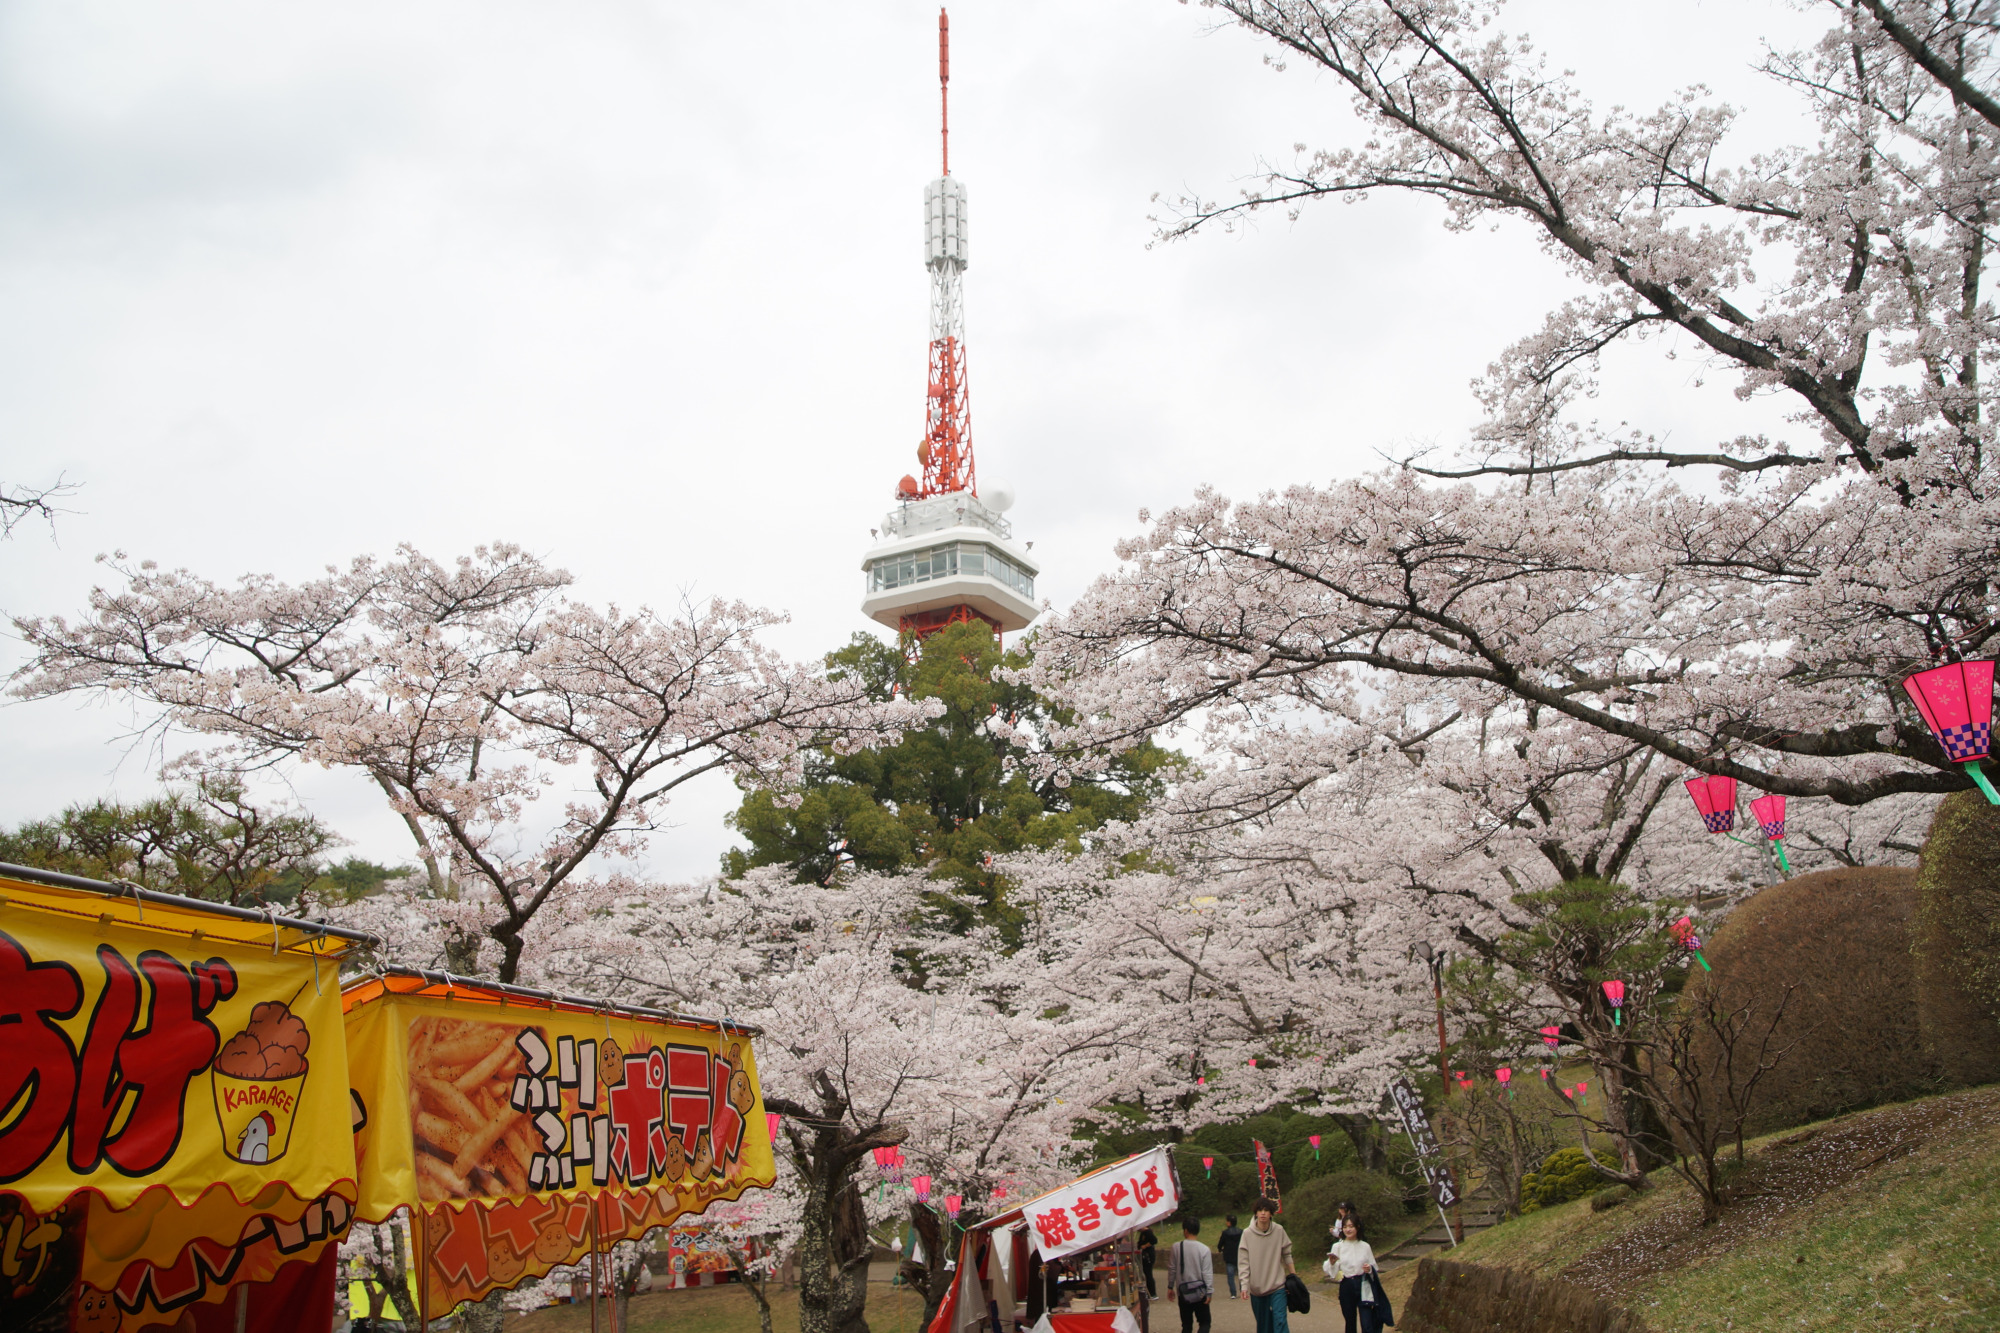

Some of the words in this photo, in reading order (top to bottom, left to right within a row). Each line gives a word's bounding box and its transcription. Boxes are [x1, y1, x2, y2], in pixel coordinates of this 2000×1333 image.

[223, 1085, 294, 1114] KARAAGE
[608, 1042, 746, 1188] ポテト
[1035, 1165, 1165, 1249] 焼きそば
